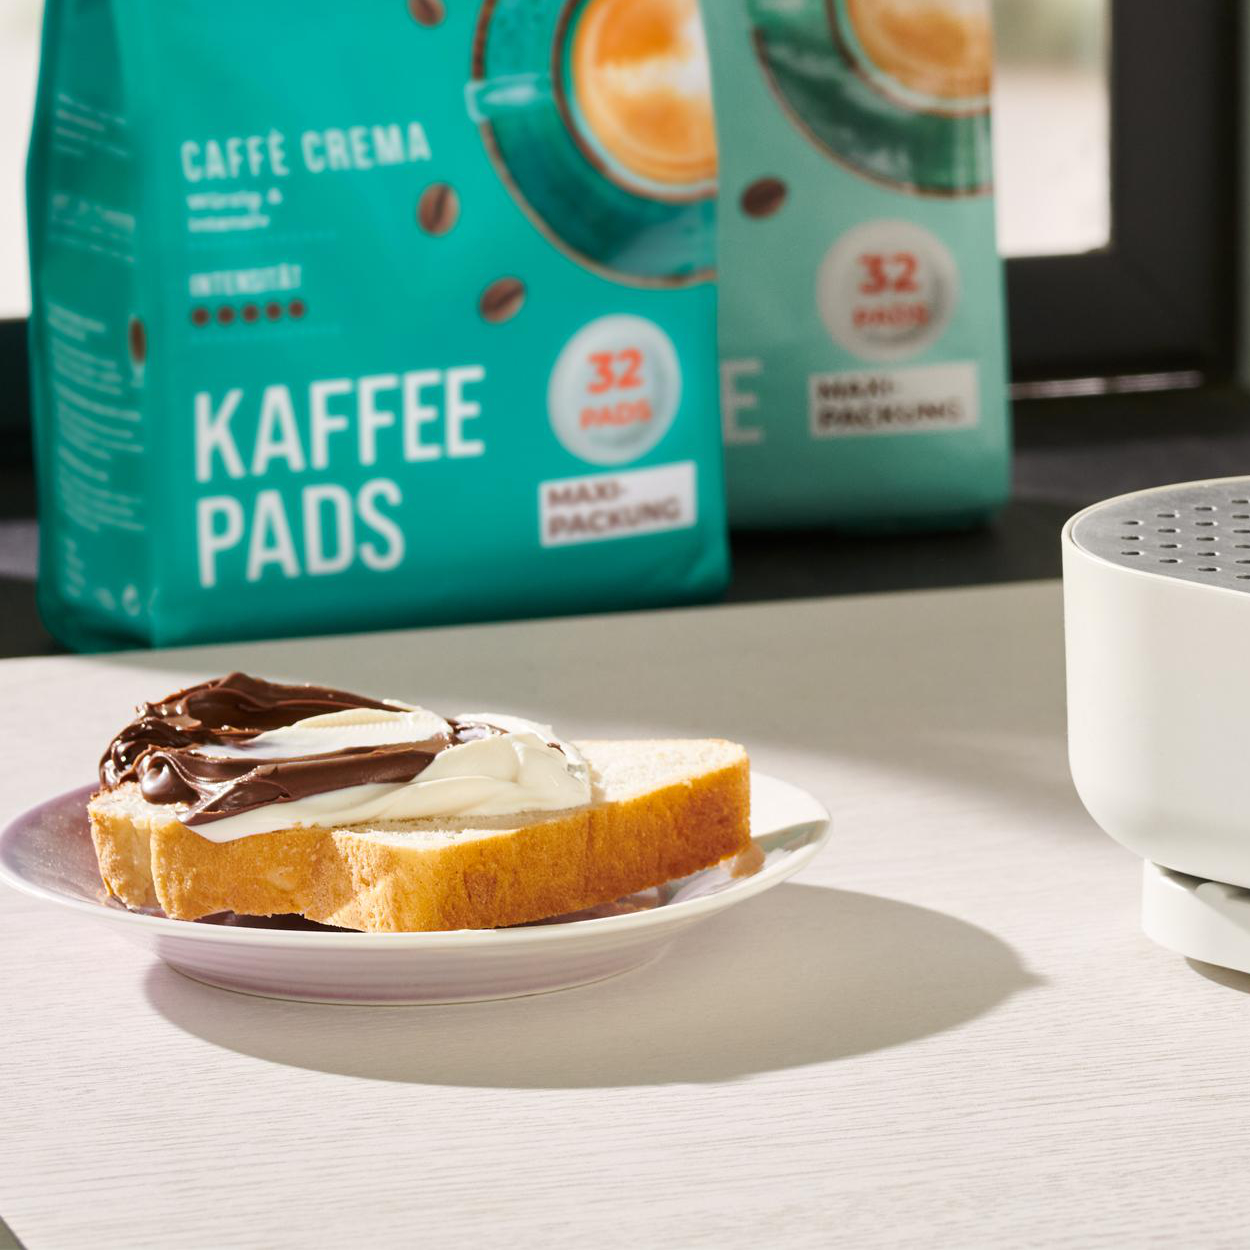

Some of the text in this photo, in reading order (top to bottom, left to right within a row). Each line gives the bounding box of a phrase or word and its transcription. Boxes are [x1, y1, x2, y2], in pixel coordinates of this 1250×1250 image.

[301, 121, 432, 174] CREMA
[858, 251, 920, 296] 32
[586, 346, 645, 395] 32
[194, 364, 486, 484] KAFFEE
[578, 399, 653, 430] PADS
[195, 477, 406, 590] PADS
[549, 495, 683, 538] PACKUNG
